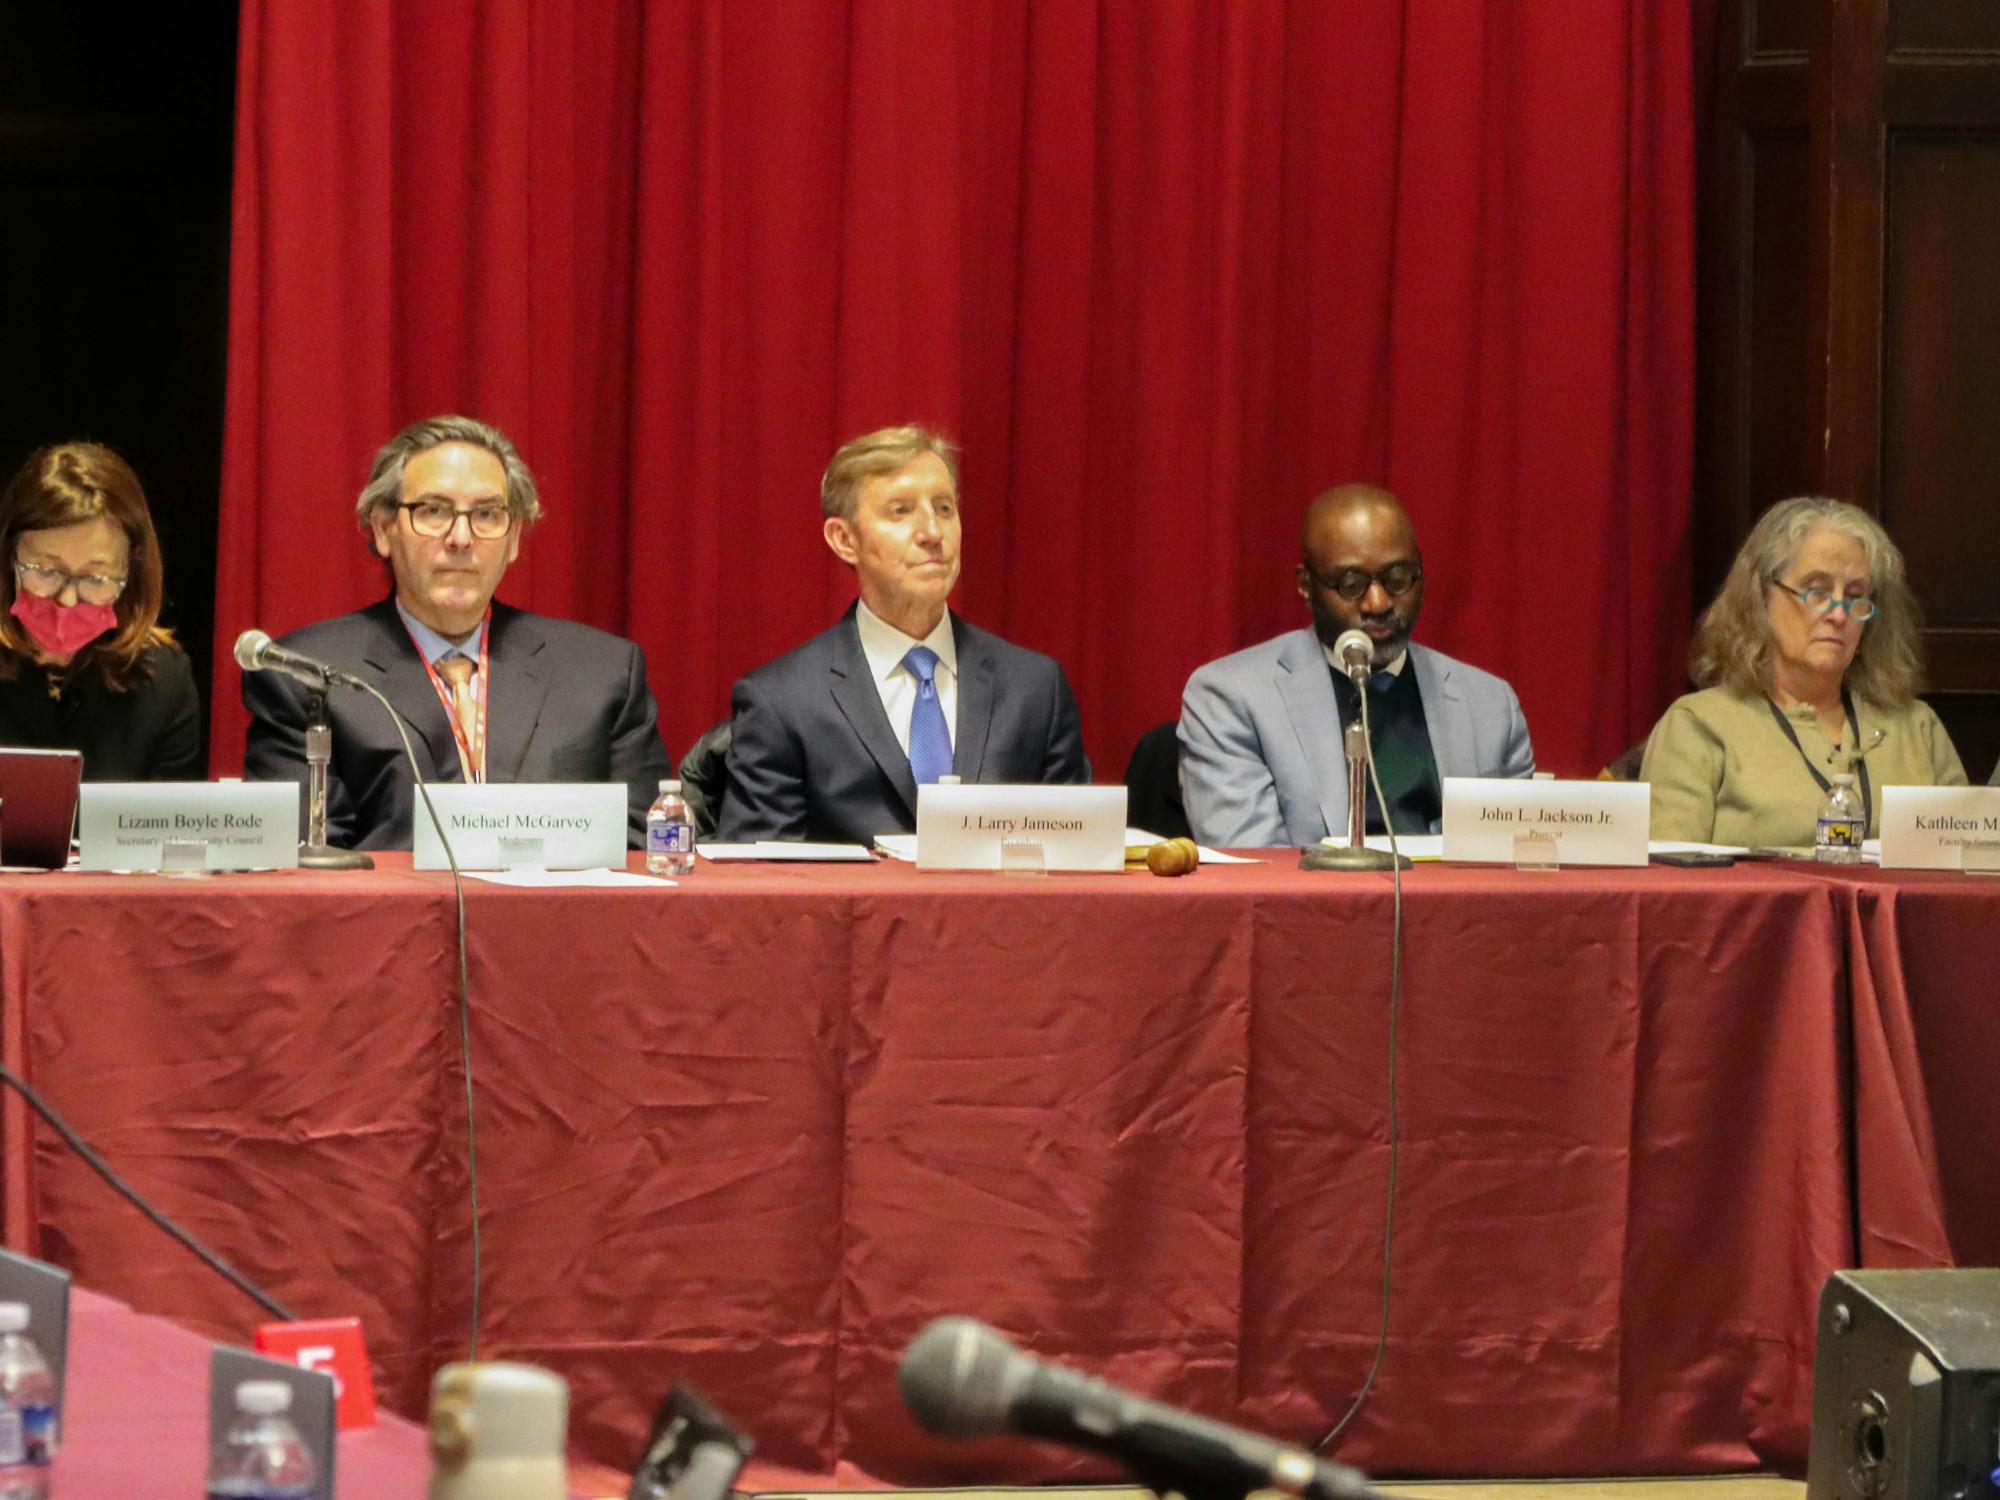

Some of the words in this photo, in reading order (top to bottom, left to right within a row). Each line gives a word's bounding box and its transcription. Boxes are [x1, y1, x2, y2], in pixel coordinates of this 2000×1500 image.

[118, 814, 169, 829] Lizann
[174, 814, 219, 832] Boyle
[223, 813, 263, 829] Rode
[450, 814, 510, 829] Michael
[515, 814, 592, 832] McGarvey
[961, 815, 973, 830] J.
[978, 815, 1016, 832] Larry
[1021, 816, 1083, 831] Jameson
[1479, 807, 1513, 822] John
[1518, 808, 1532, 823] L.
[1537, 808, 1593, 824] Jackson
[1597, 810, 1614, 825] Jr.
[1915, 815, 1978, 831] Kathleen
